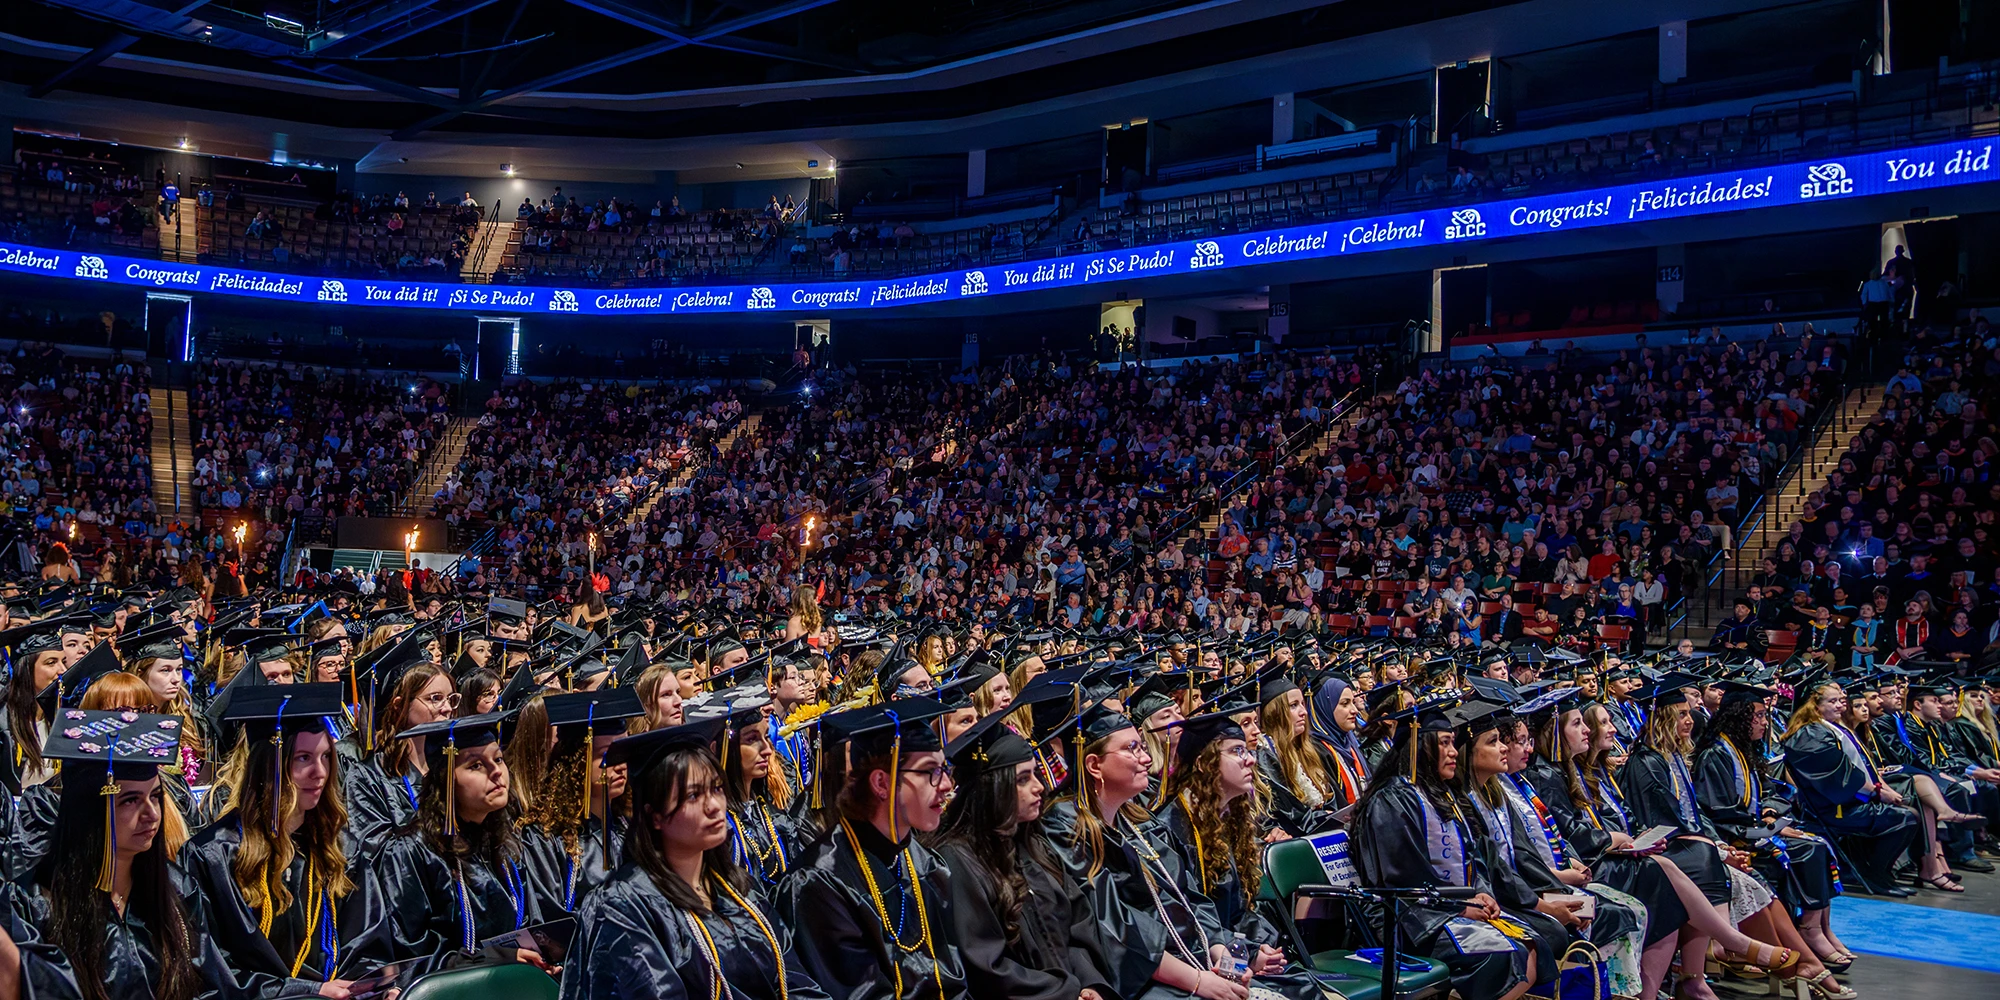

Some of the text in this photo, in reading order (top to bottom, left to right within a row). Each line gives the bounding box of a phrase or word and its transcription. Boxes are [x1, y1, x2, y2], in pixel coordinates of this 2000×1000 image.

[1885, 145, 1992, 182] You did
[1628, 175, 1773, 219] ¡Felicidades!
[1800, 178, 1854, 199] SLCC
[1509, 195, 1612, 228] Congrats!
[1340, 218, 1425, 252] ¡Celebra!
[1444, 222, 1486, 240] SLCC
[1242, 230, 1328, 258] Celebrate!
[1084, 250, 1175, 282] ¡Si Se Pudo!
[1190, 253, 1224, 269] SLCC
[75, 266, 109, 279] SLCC
[125, 263, 201, 286] Congrats!
[1004, 262, 1075, 286] You did it!
[1659, 267, 1681, 281] 114
[210, 272, 304, 295] ¡Felicidades!
[870, 278, 949, 306] ¡Felicidades!
[960, 282, 989, 296] SLCC
[317, 290, 348, 302] SLCC
[365, 285, 439, 302] You did it!
[448, 289, 535, 307] ¡Si Se Pudo!
[595, 293, 663, 309] Celebrate!
[671, 291, 733, 312] ¡Celebra!
[791, 287, 861, 309] Congrats!
[548, 301, 579, 312] SLCC
[746, 297, 776, 309] SLCC
[1271, 303, 1287, 316] 115
[965, 322, 978, 334] 116
[1439, 820, 1453, 860] LCC
[1316, 841, 1350, 858] RESERVE
[1325, 863, 1335, 872] For
[1332, 874, 1339, 882] of
